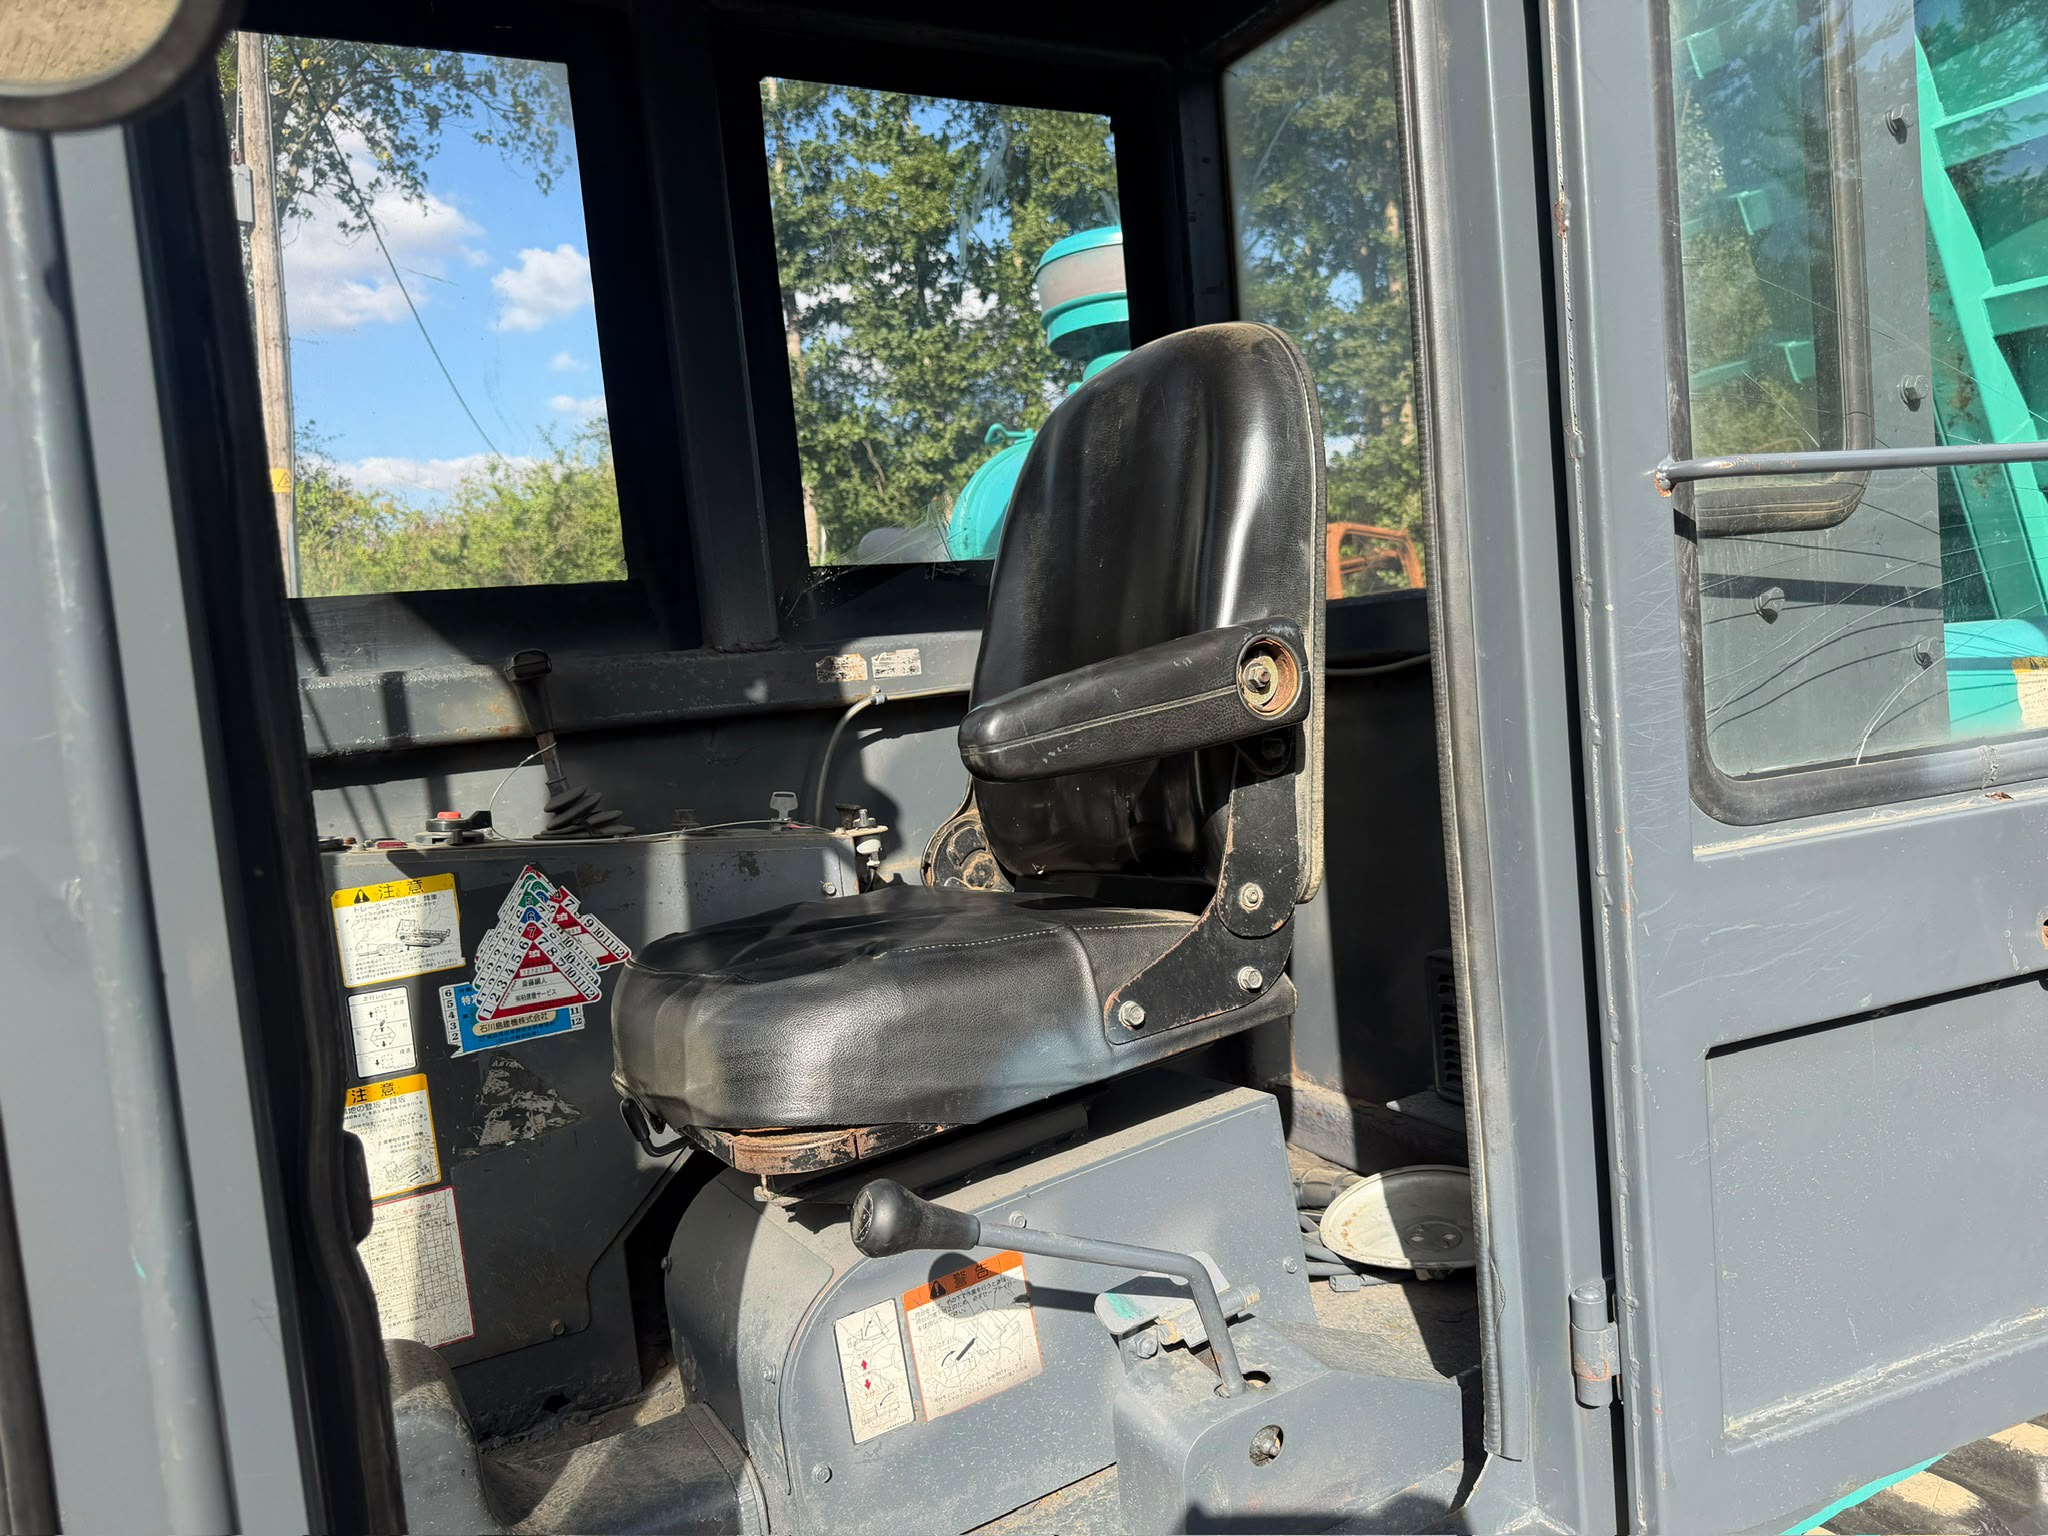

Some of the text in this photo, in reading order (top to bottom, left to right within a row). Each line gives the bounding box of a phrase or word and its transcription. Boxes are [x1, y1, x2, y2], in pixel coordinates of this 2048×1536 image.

[378, 879, 425, 900] 注意
[527, 926, 537, 938] 7
[584, 919, 594, 928] 9
[593, 927, 606, 939] 10
[603, 936, 615, 949] 11
[612, 946, 625, 958] 12
[490, 992, 501, 1002] 2
[497, 980, 508, 990] 3
[505, 967, 515, 976] 4
[511, 953, 522, 964] 5
[519, 941, 530, 950] 6
[538, 936, 549, 945] 7
[547, 947, 558, 957] 8
[565, 967, 577, 978] 10
[573, 977, 586, 987] 11
[583, 986, 596, 998] 12
[444, 989, 453, 998] 6
[446, 999, 454, 1009] 5
[448, 1011, 455, 1019] 4
[570, 1007, 580, 1015] 11
[449, 1022, 457, 1030] 3
[479, 1012, 549, 1034] 石川島建機株式会社
[571, 1018, 582, 1026] 12
[451, 1033, 459, 1041] 2
[351, 1081, 397, 1104] 注意
[953, 1262, 989, 1289] 警告
